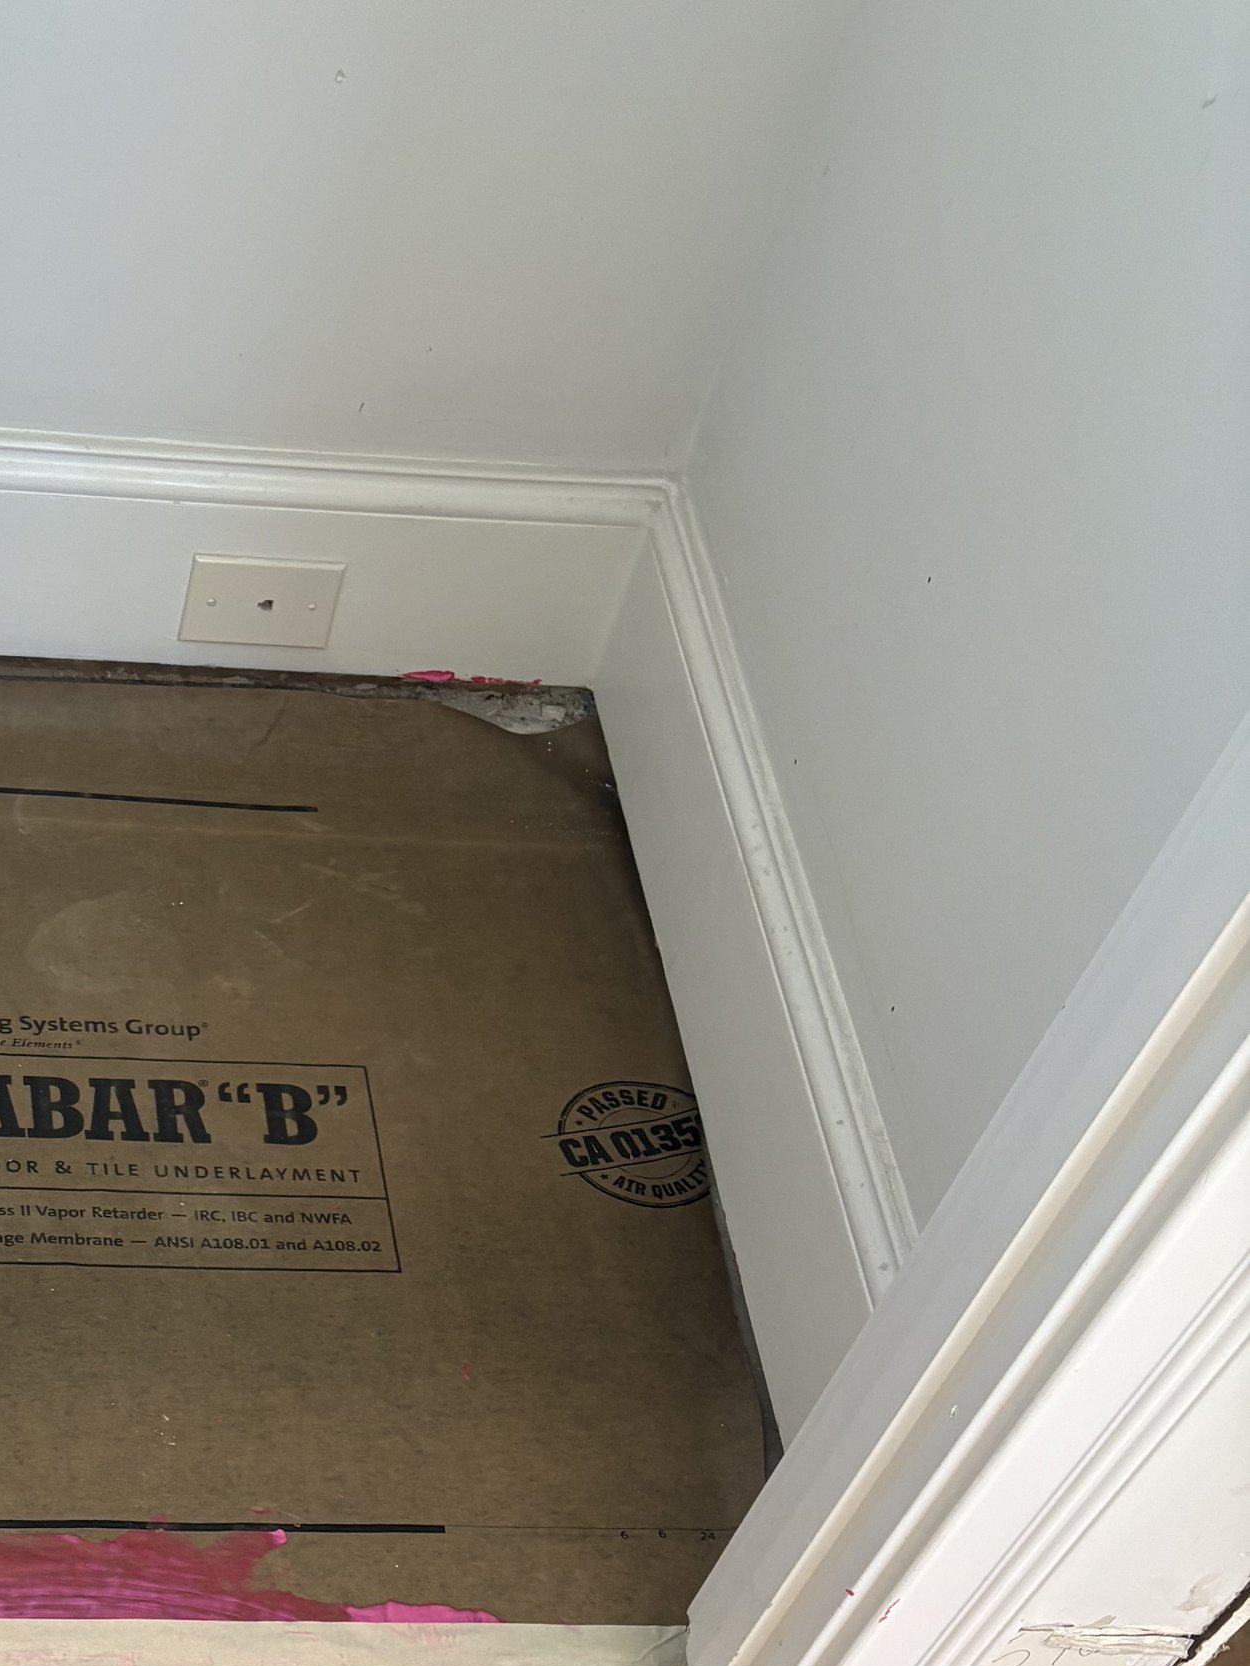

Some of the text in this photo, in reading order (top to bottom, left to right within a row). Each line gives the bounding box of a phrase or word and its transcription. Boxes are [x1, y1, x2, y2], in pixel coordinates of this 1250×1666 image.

[19, 1015, 118, 1036] Systems
[218, 1082, 347, 1145] “B”
[576, 1090, 668, 1121] PASSED
[559, 1136, 613, 1168] CA
[55, 1160, 72, 1174] &
[86, 1162, 139, 1177] TILE
[154, 1165, 360, 1183] UNDERLAYMENT
[613, 1175, 646, 1196] AIR
[20, 1204, 31, 1216] II
[35, 1205, 86, 1220] Vapor
[92, 1207, 164, 1220] Retarder
[194, 1210, 226, 1223] IRC,
[232, 1210, 258, 1222] IBC
[264, 1211, 295, 1224] and
[301, 1212, 352, 1225] NWFA
[31, 1232, 124, 1247] Membrane
[154, 1236, 194, 1248] ANSI
[201, 1237, 270, 1250] A108.01
[276, 1238, 307, 1251] and
[313, 1240, 382, 1252] A108.02
[620, 1529, 716, 1541] 6 6 24
